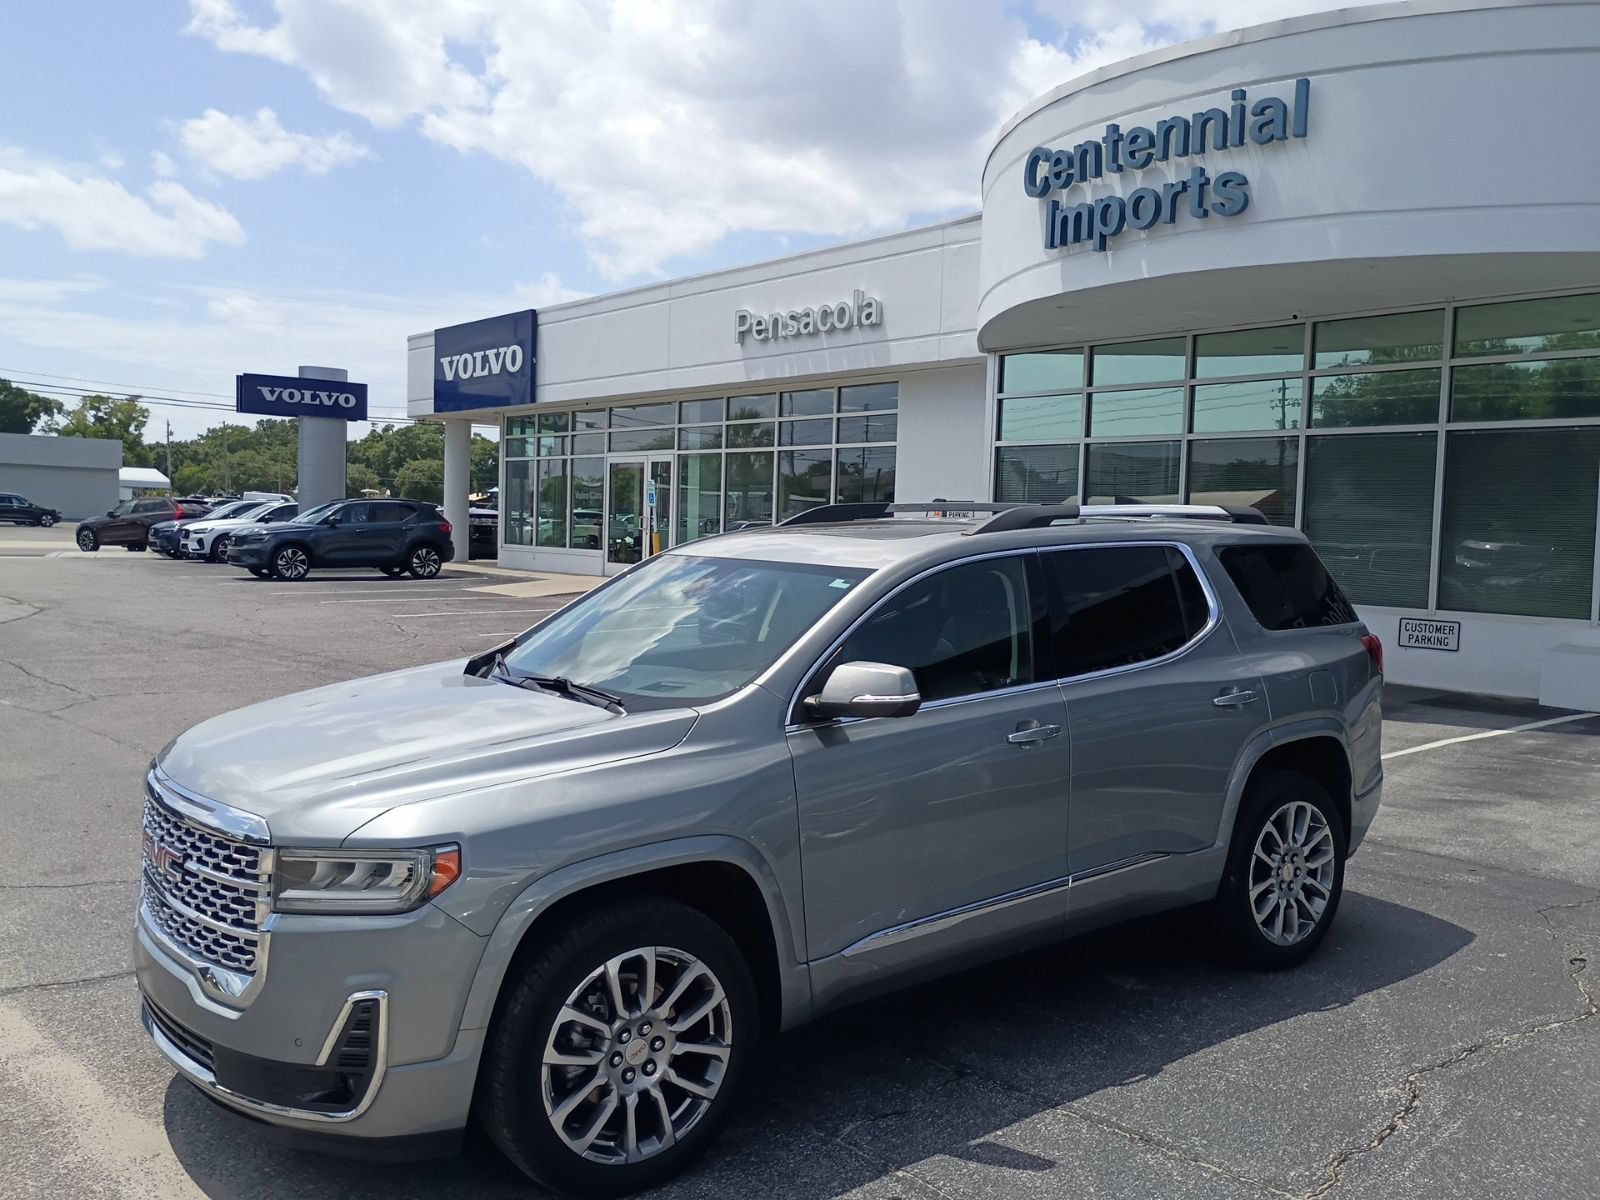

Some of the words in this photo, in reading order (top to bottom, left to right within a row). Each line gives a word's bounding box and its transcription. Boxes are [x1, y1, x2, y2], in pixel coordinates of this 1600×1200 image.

[1024, 78, 1310, 198] Centennial
[1045, 167, 1250, 252] Imports
[734, 289, 883, 344] Pensacola
[440, 345, 523, 381] VOLVO
[257, 386, 357, 408] VOLVO
[1404, 622, 1455, 635] CUSTOMER
[1408, 633, 1449, 647] PARKING
